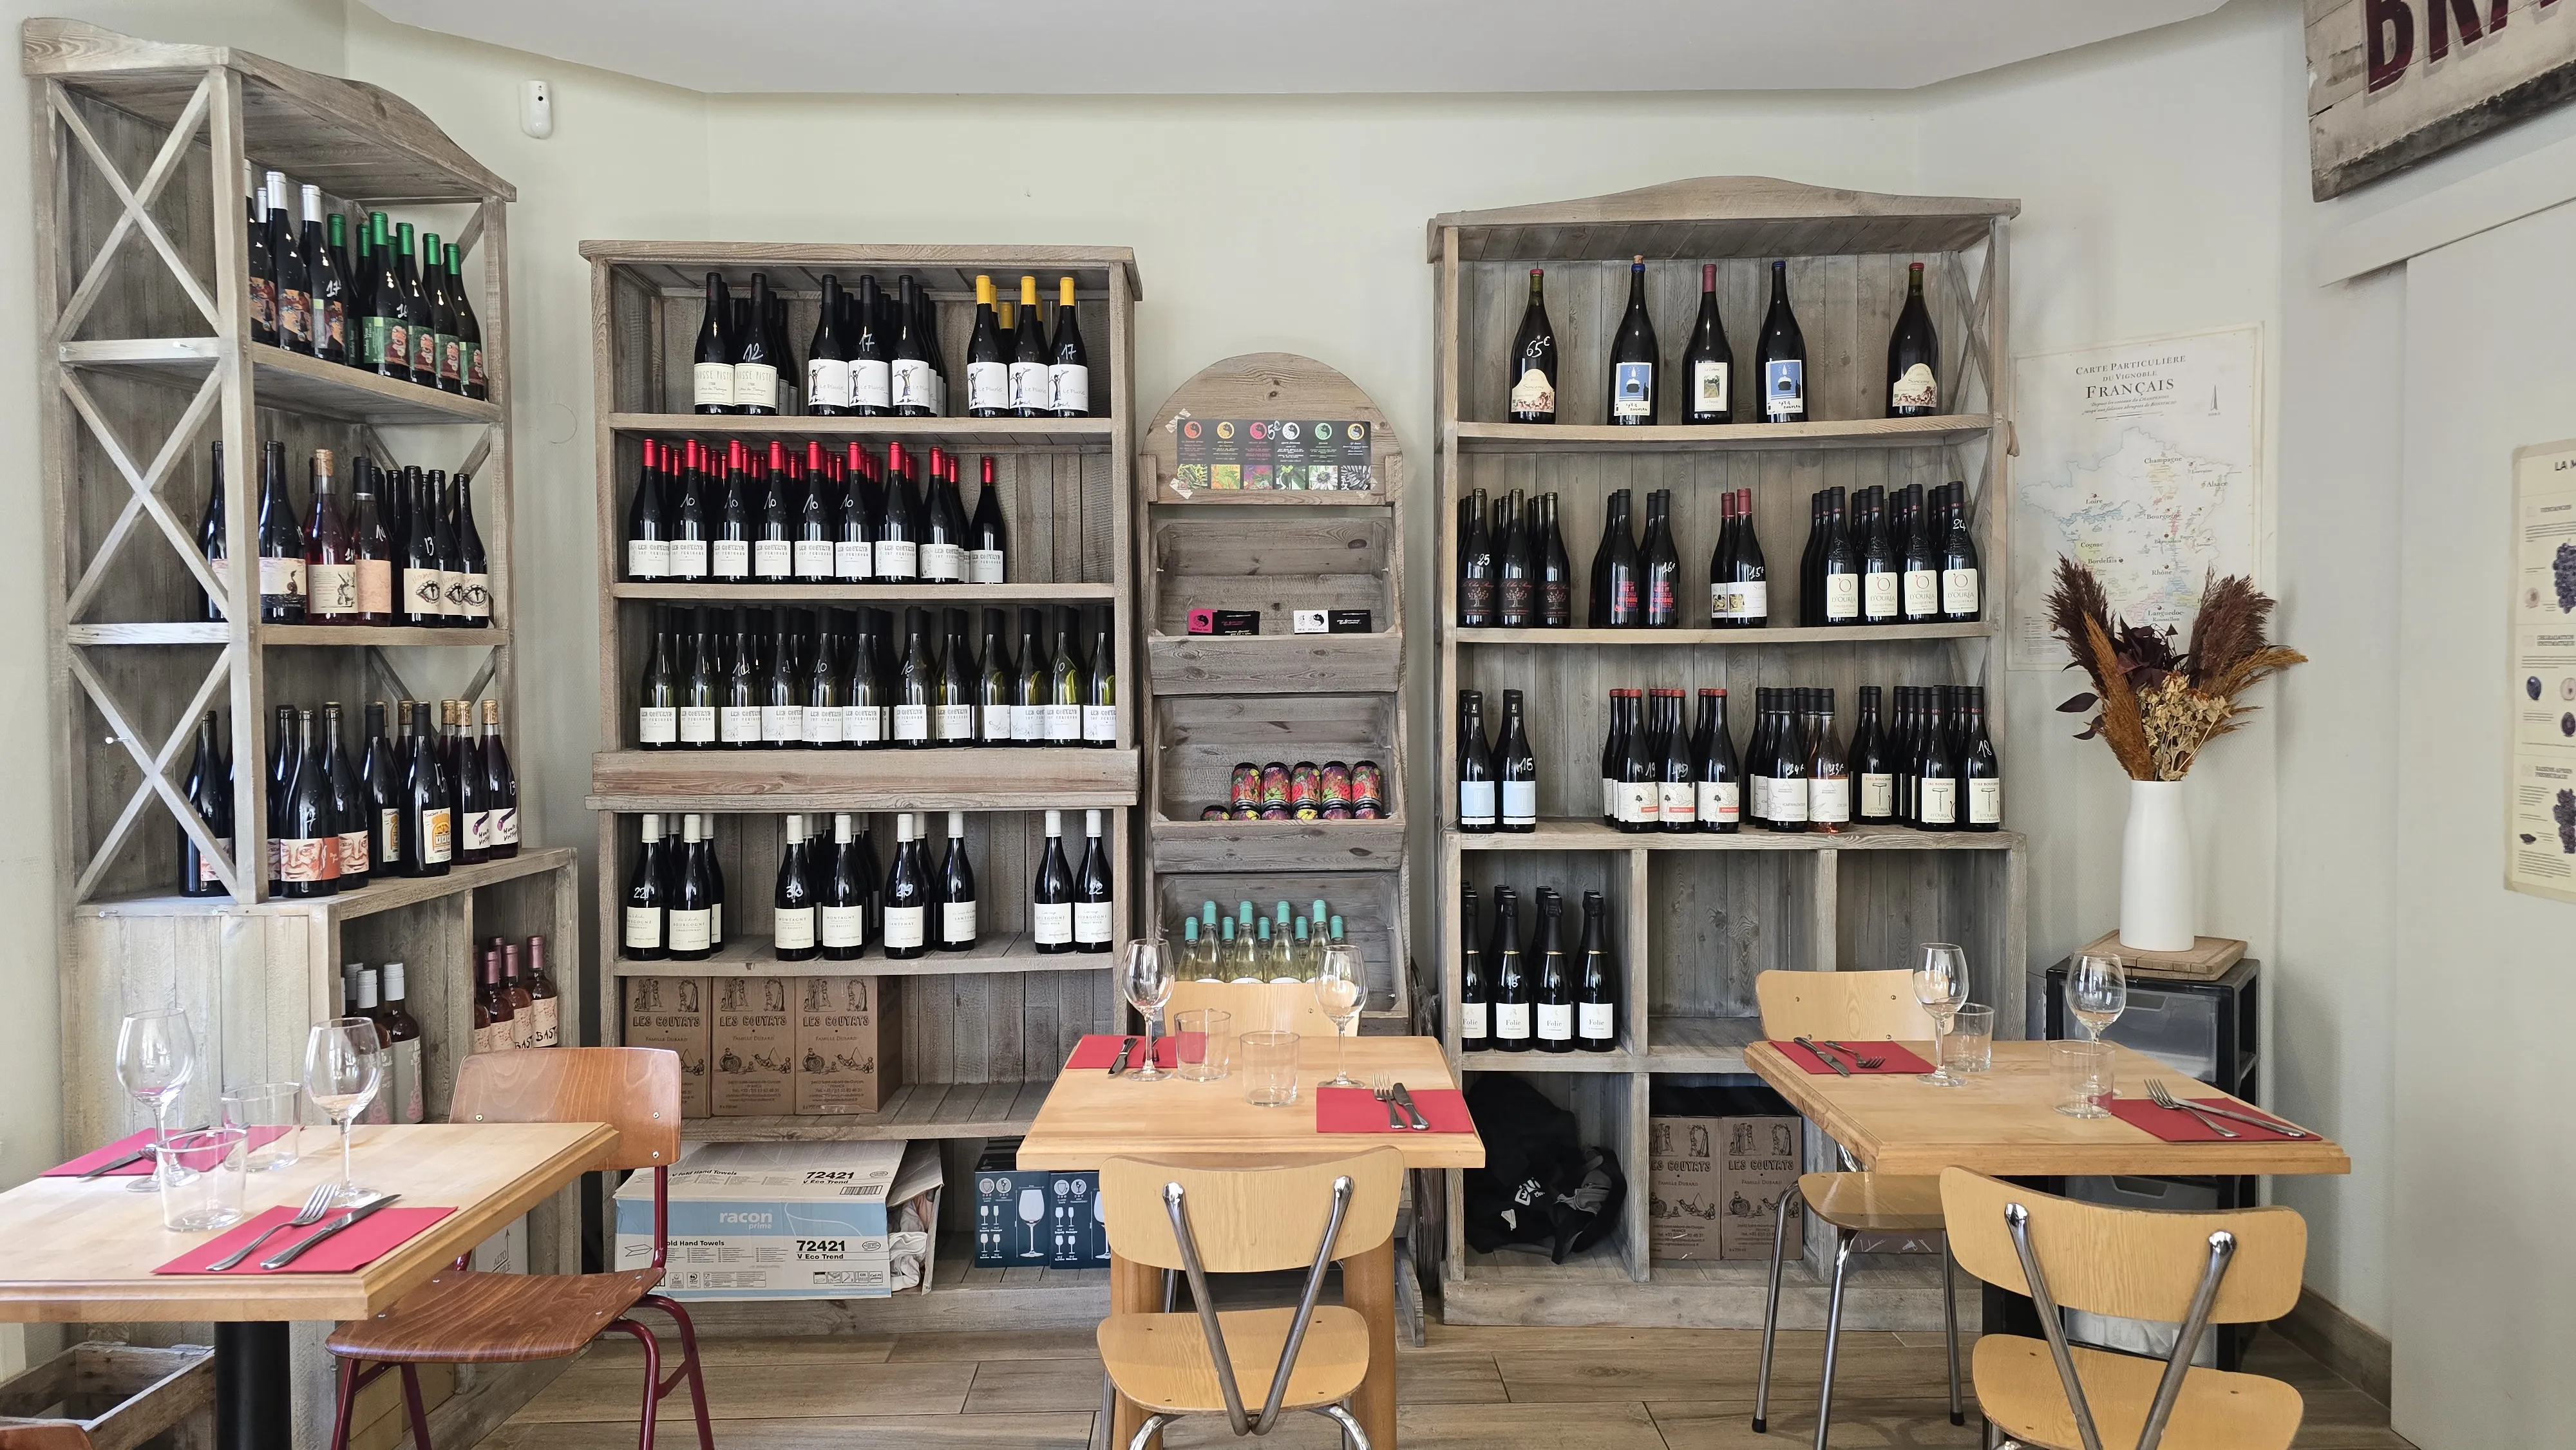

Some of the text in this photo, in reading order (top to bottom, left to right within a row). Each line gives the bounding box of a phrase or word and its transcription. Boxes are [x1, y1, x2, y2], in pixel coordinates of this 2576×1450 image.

[743, 343, 764, 362] 12
[2076, 355, 2186, 375] CARTE PARTICULIÈRE
[2116, 370, 2157, 380] VIGNOBLE
[2085, 379, 2174, 399] FRANÇAIS
[2554, 461, 2568, 471] LA
[681, 493, 696, 507] 10
[724, 490, 739, 508] 10
[764, 491, 777, 509] 10
[803, 494, 819, 513] 10
[840, 494, 854, 509] 10
[1953, 519, 1966, 532] 24
[1978, 740, 1992, 758] 18
[633, 1016, 700, 1027] LES COUYATS
[719, 1015, 787, 1027] LES COUYATS
[803, 1015, 869, 1027] LES COUYATS
[1651, 1160, 1711, 1172] ES COUYATS
[1728, 1160, 1794, 1171] LES COUYATS
[806, 1171, 855, 1180] 72421
[719, 1212, 773, 1223] racon
[796, 1240, 846, 1252] 72421
